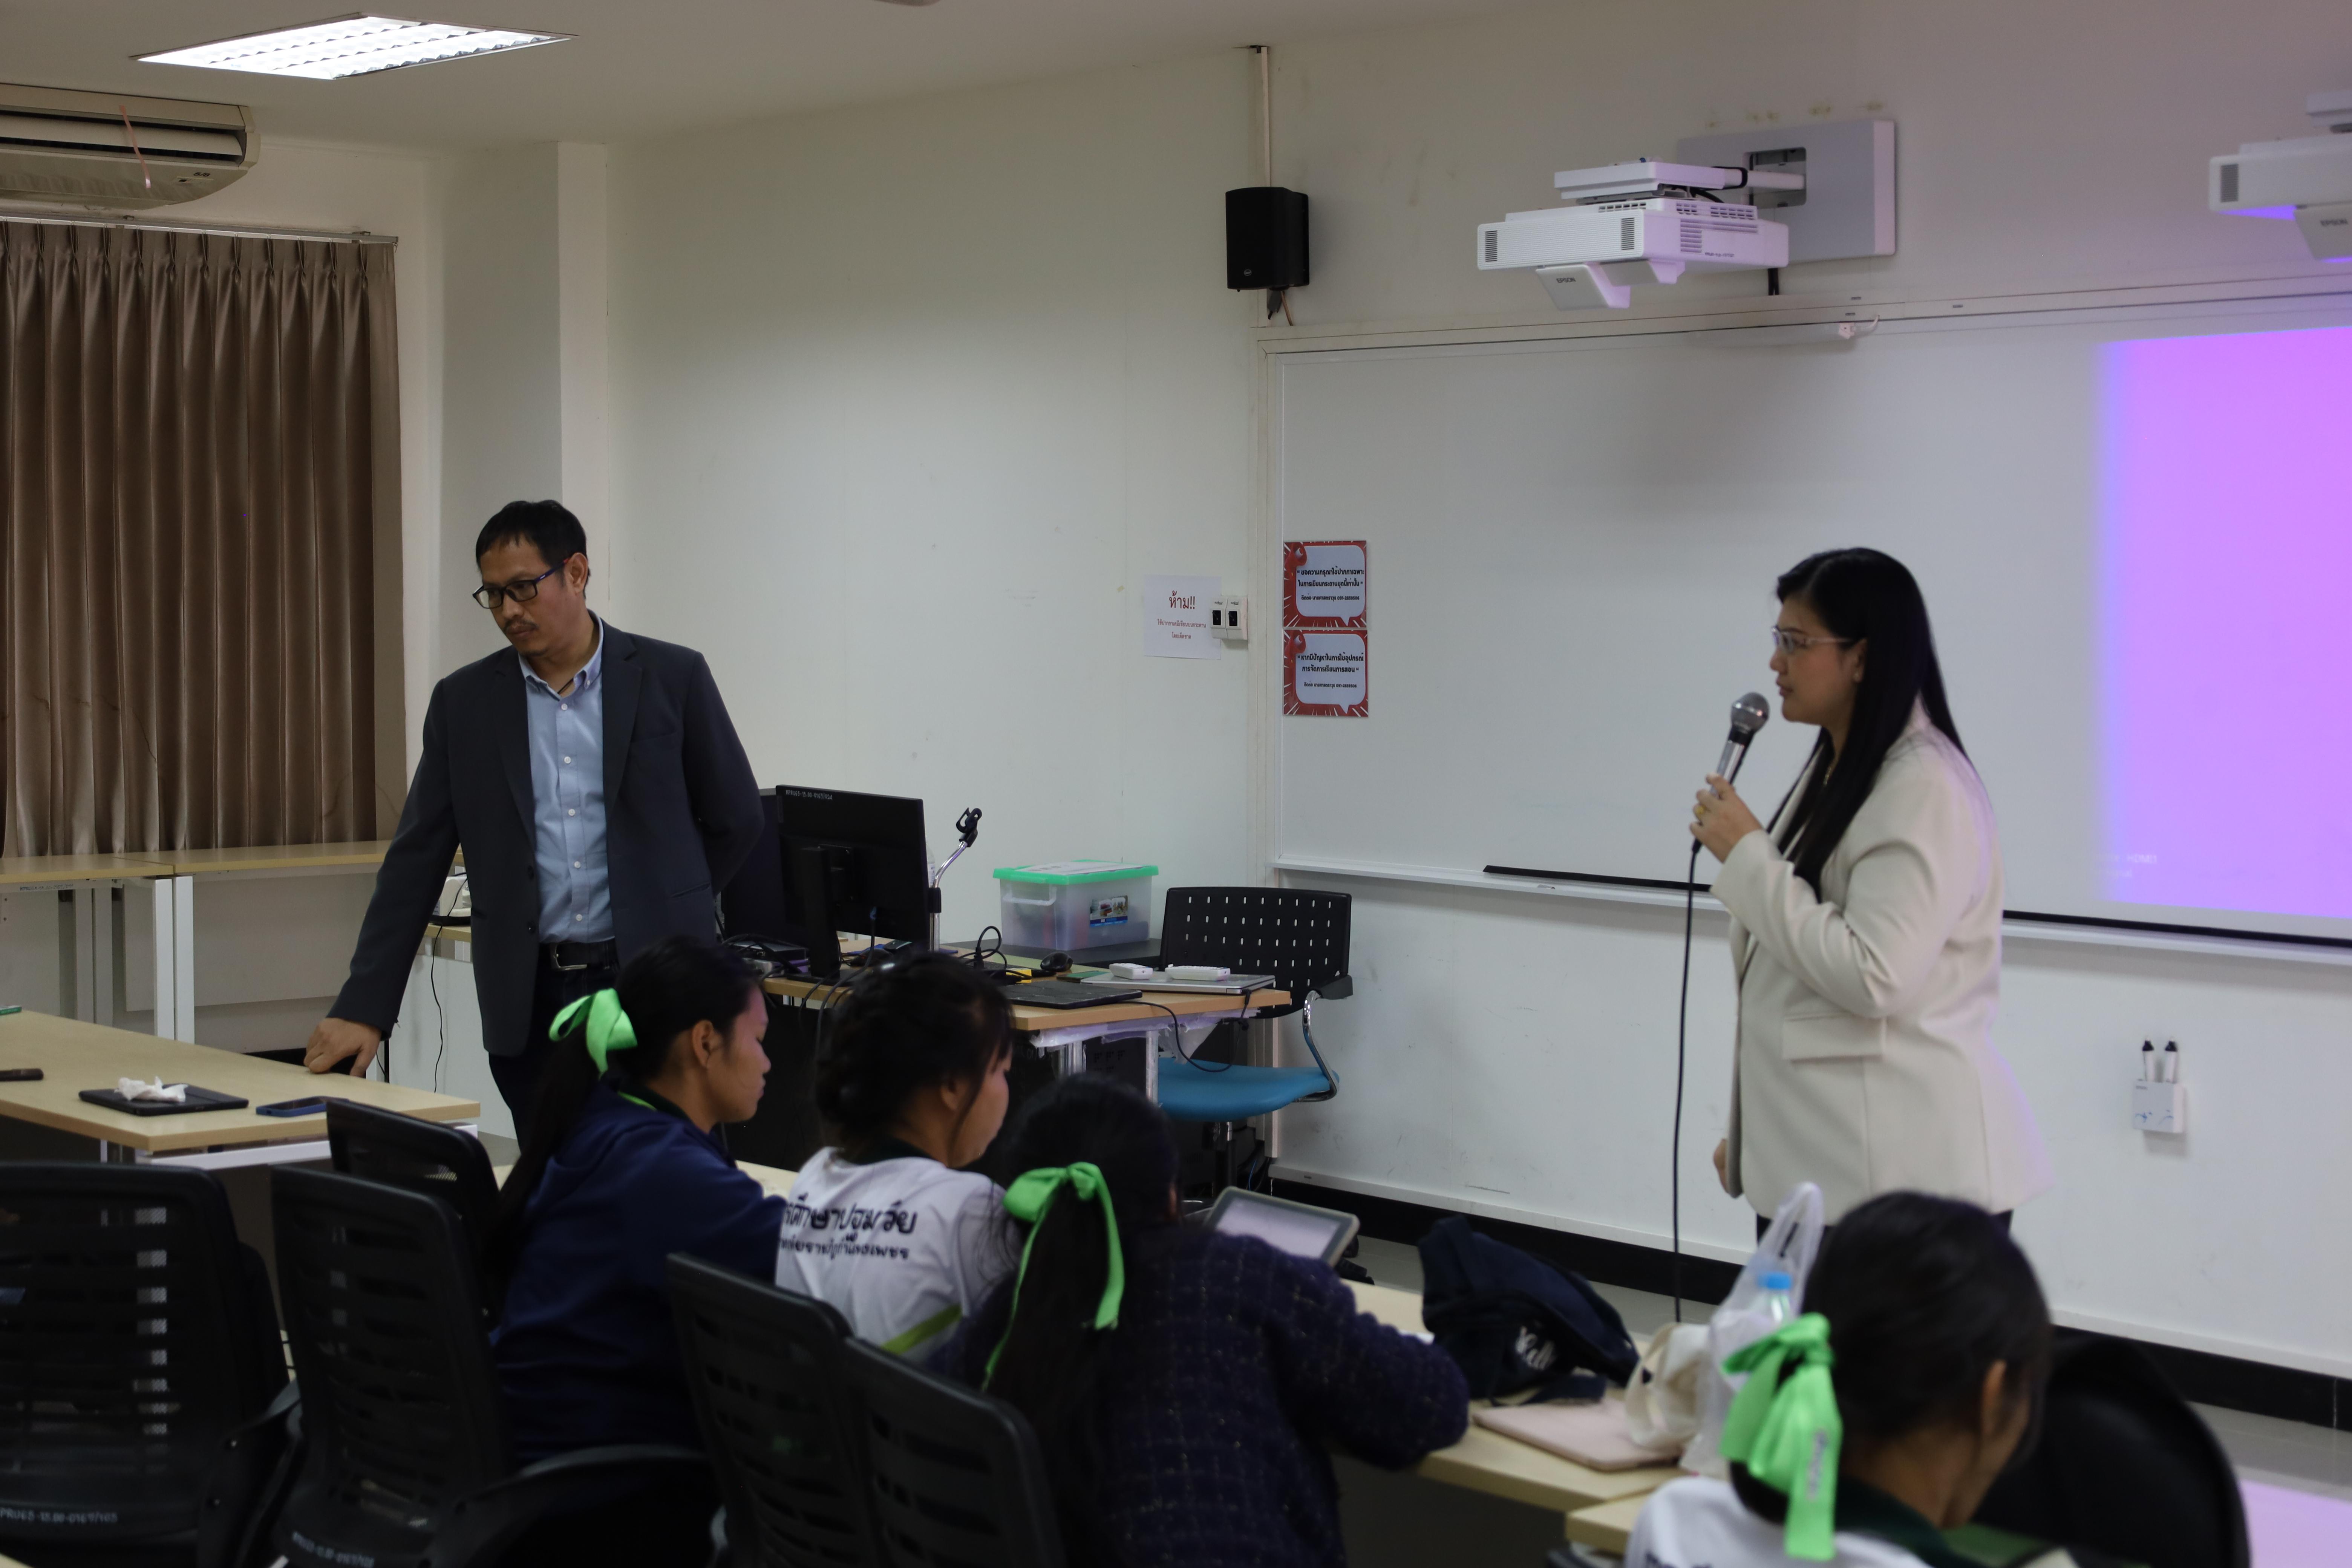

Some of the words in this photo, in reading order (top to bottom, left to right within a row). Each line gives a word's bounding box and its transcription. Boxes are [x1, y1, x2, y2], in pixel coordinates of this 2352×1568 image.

[1169, 590, 1195, 609] ห้าม!!
[1158, 619, 1207, 628] ใช้ปากกาเคมีเขียนบนกระดาน
[1302, 664, 1355, 672] การจัดการเรียนการสอน
